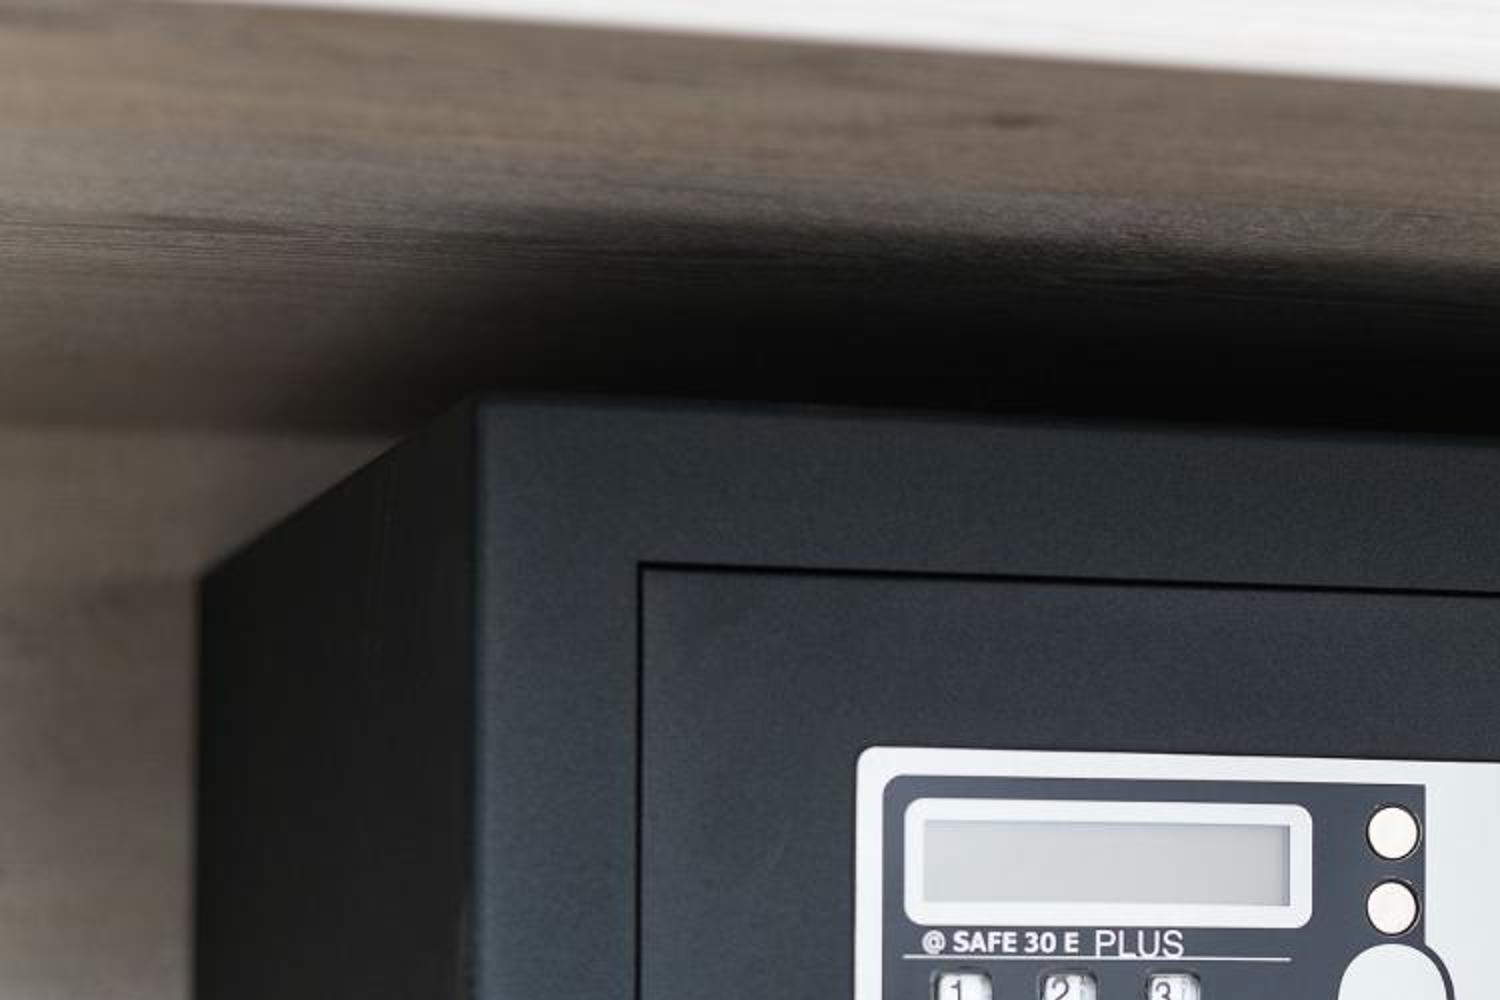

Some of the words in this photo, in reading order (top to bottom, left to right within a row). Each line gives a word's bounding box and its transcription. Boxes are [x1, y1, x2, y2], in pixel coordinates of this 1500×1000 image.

[952, 931, 1018, 953] SAFE
[1024, 931, 1057, 953] 30
[1064, 931, 1080, 953] E
[1095, 929, 1185, 957] PLUS
